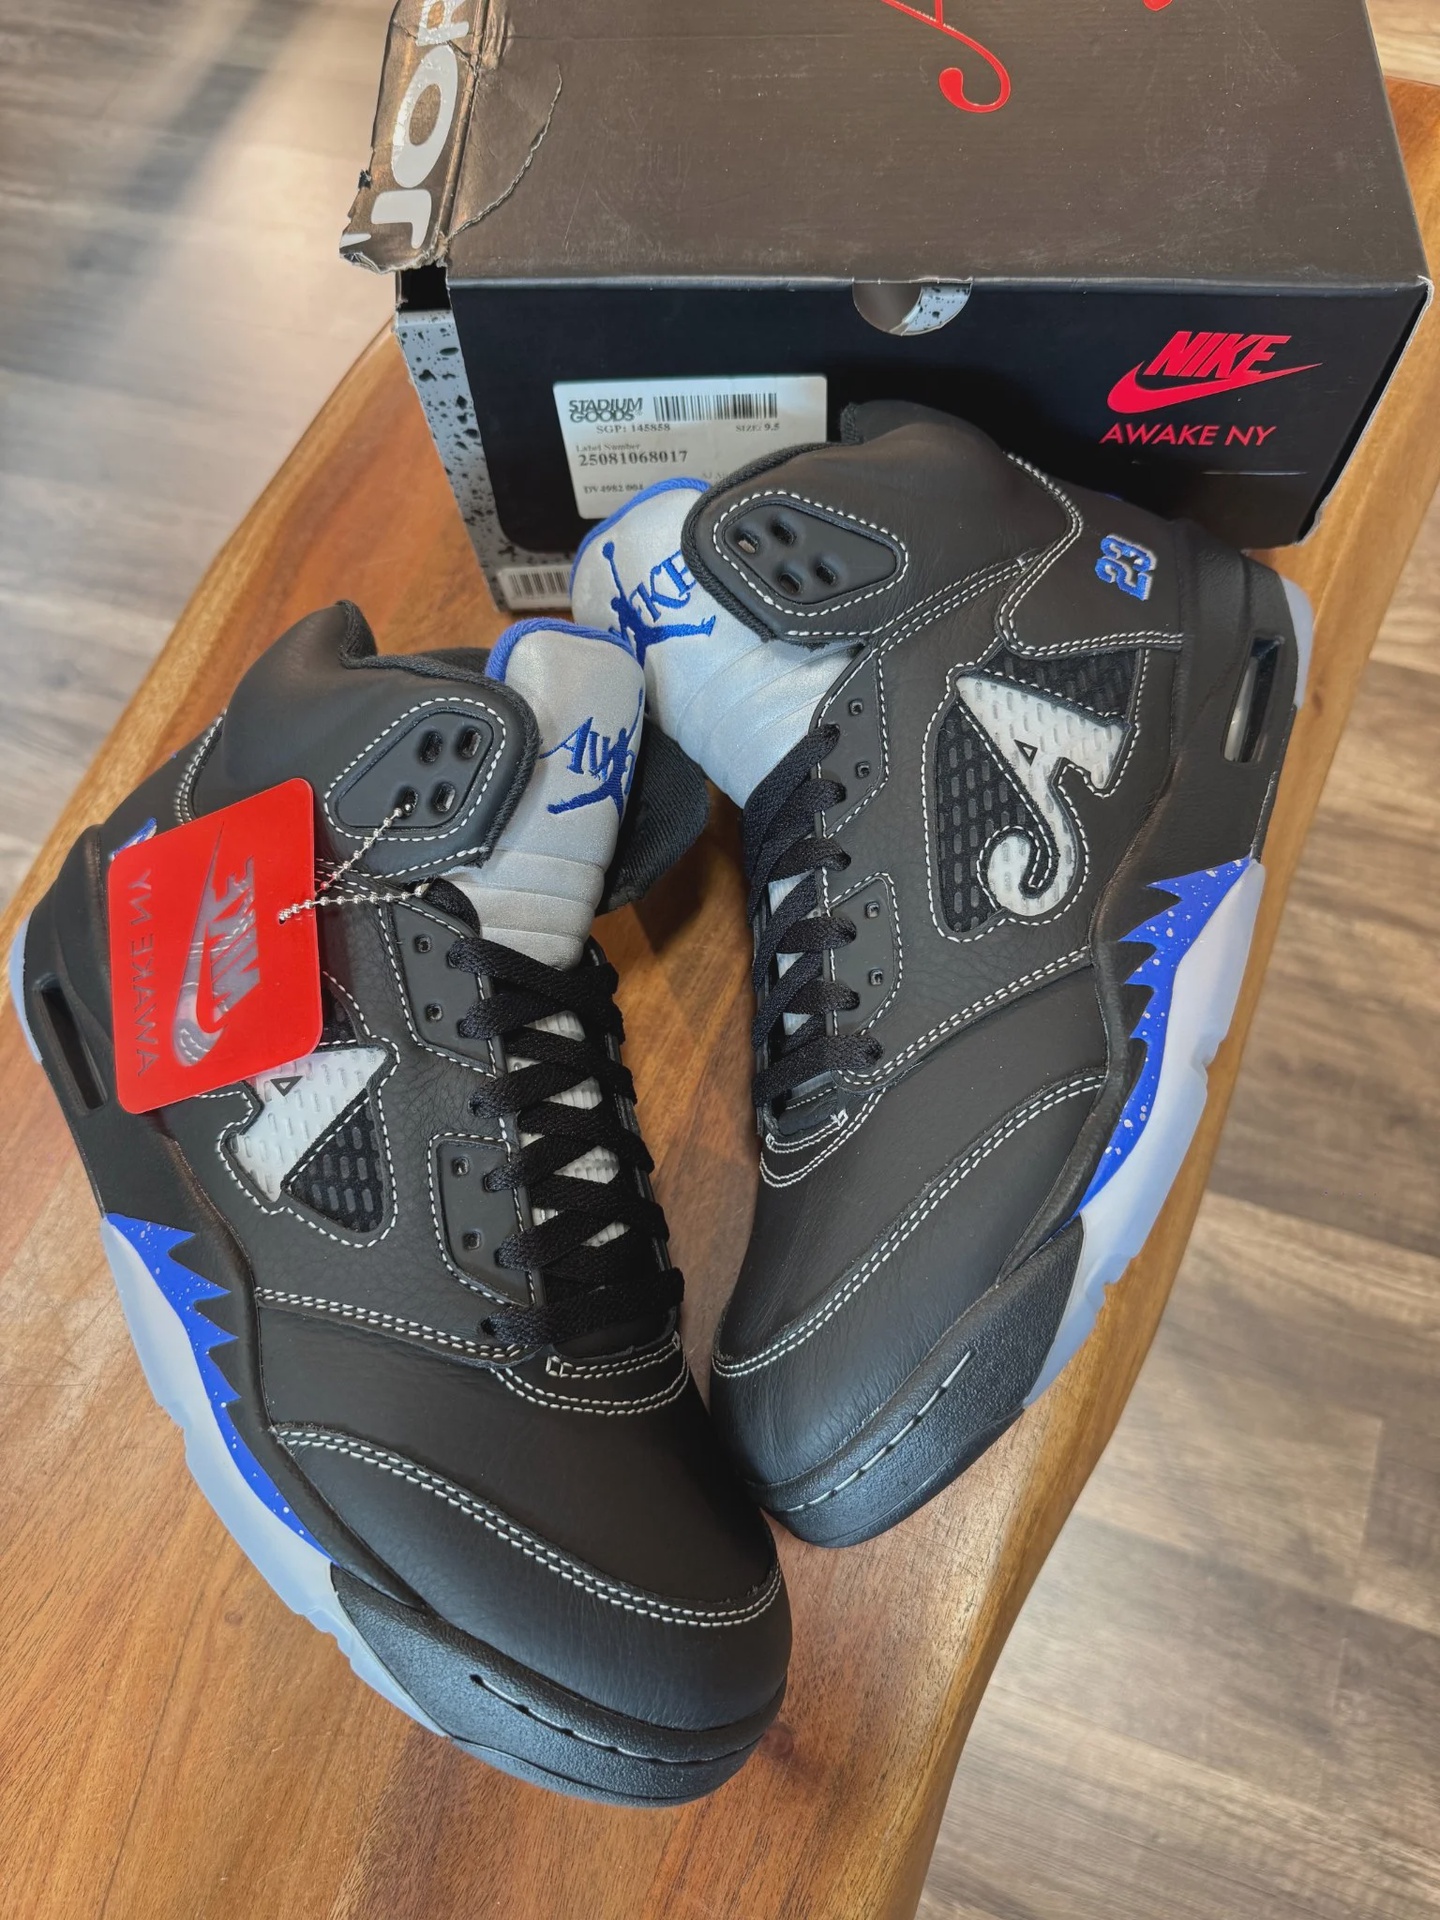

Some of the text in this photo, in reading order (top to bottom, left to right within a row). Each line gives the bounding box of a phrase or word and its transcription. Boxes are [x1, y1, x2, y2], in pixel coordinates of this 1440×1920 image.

[1143, 330, 1292, 380] NIKE
[569, 397, 643, 413] STADIUM
[570, 409, 636, 423] GOODS
[631, 423, 671, 433] 145858
[764, 422, 780, 432] 9.5
[1099, 422, 1276, 446] AWAKE NY
[578, 450, 689, 467] 25081068017
